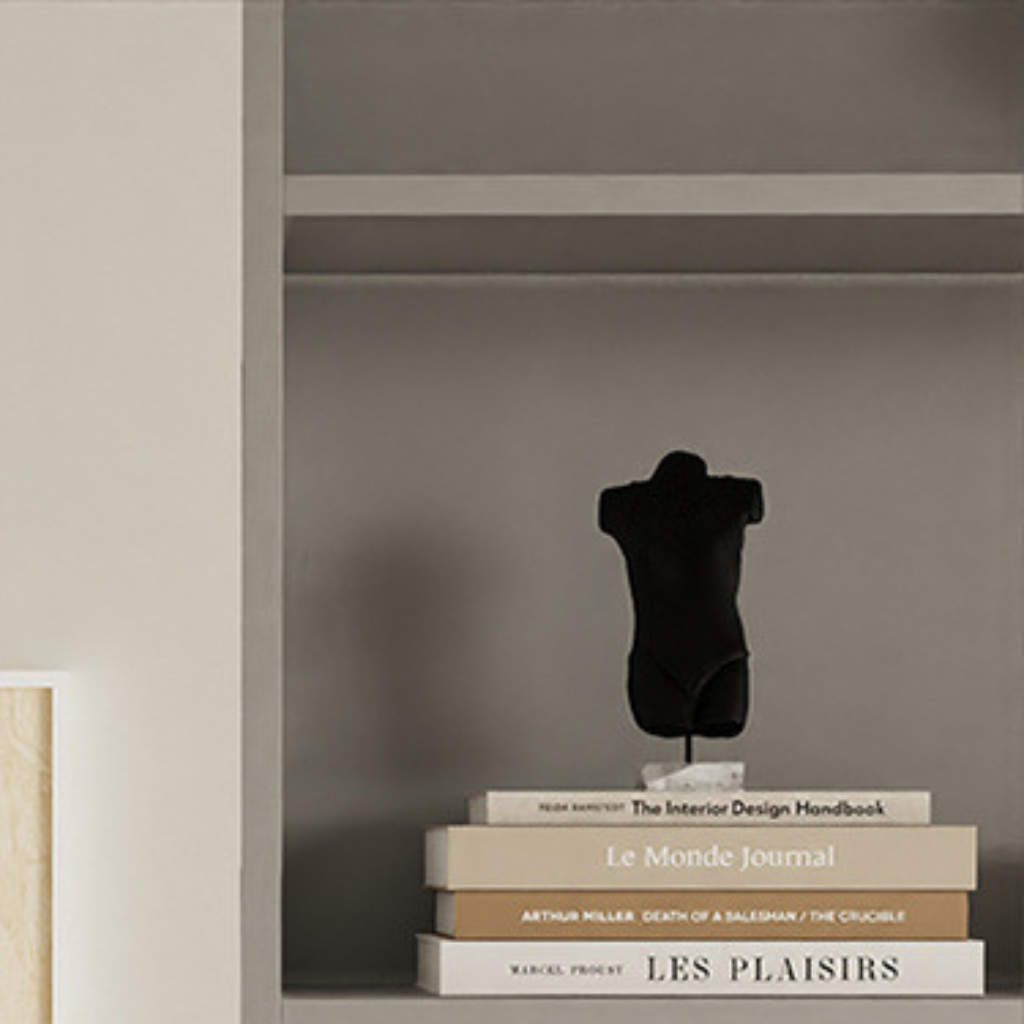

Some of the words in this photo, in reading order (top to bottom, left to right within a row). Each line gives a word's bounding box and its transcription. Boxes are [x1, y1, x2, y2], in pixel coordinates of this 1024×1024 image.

[631, 800, 662, 816] The
[666, 800, 726, 816] Interior
[732, 800, 791, 818] Design
[796, 800, 885, 816] Handbook
[606, 846, 635, 868] Le
[644, 845, 733, 868] Monde
[739, 845, 835, 872] Journal
[521, 911, 580, 922] ARTHUR
[583, 911, 635, 922] MILLER
[641, 911, 689, 922] DEATH
[690, 911, 709, 922] OF
[711, 911, 723, 922] A
[725, 911, 796, 922] SALESMAN
[810, 911, 835, 922] THE
[837, 911, 905, 922] CRUCIBLE
[510, 965, 565, 975] MARCEL
[570, 965, 623, 975] PROUST
[647, 956, 711, 982] LES
[731, 956, 899, 982] PLAISIRS
